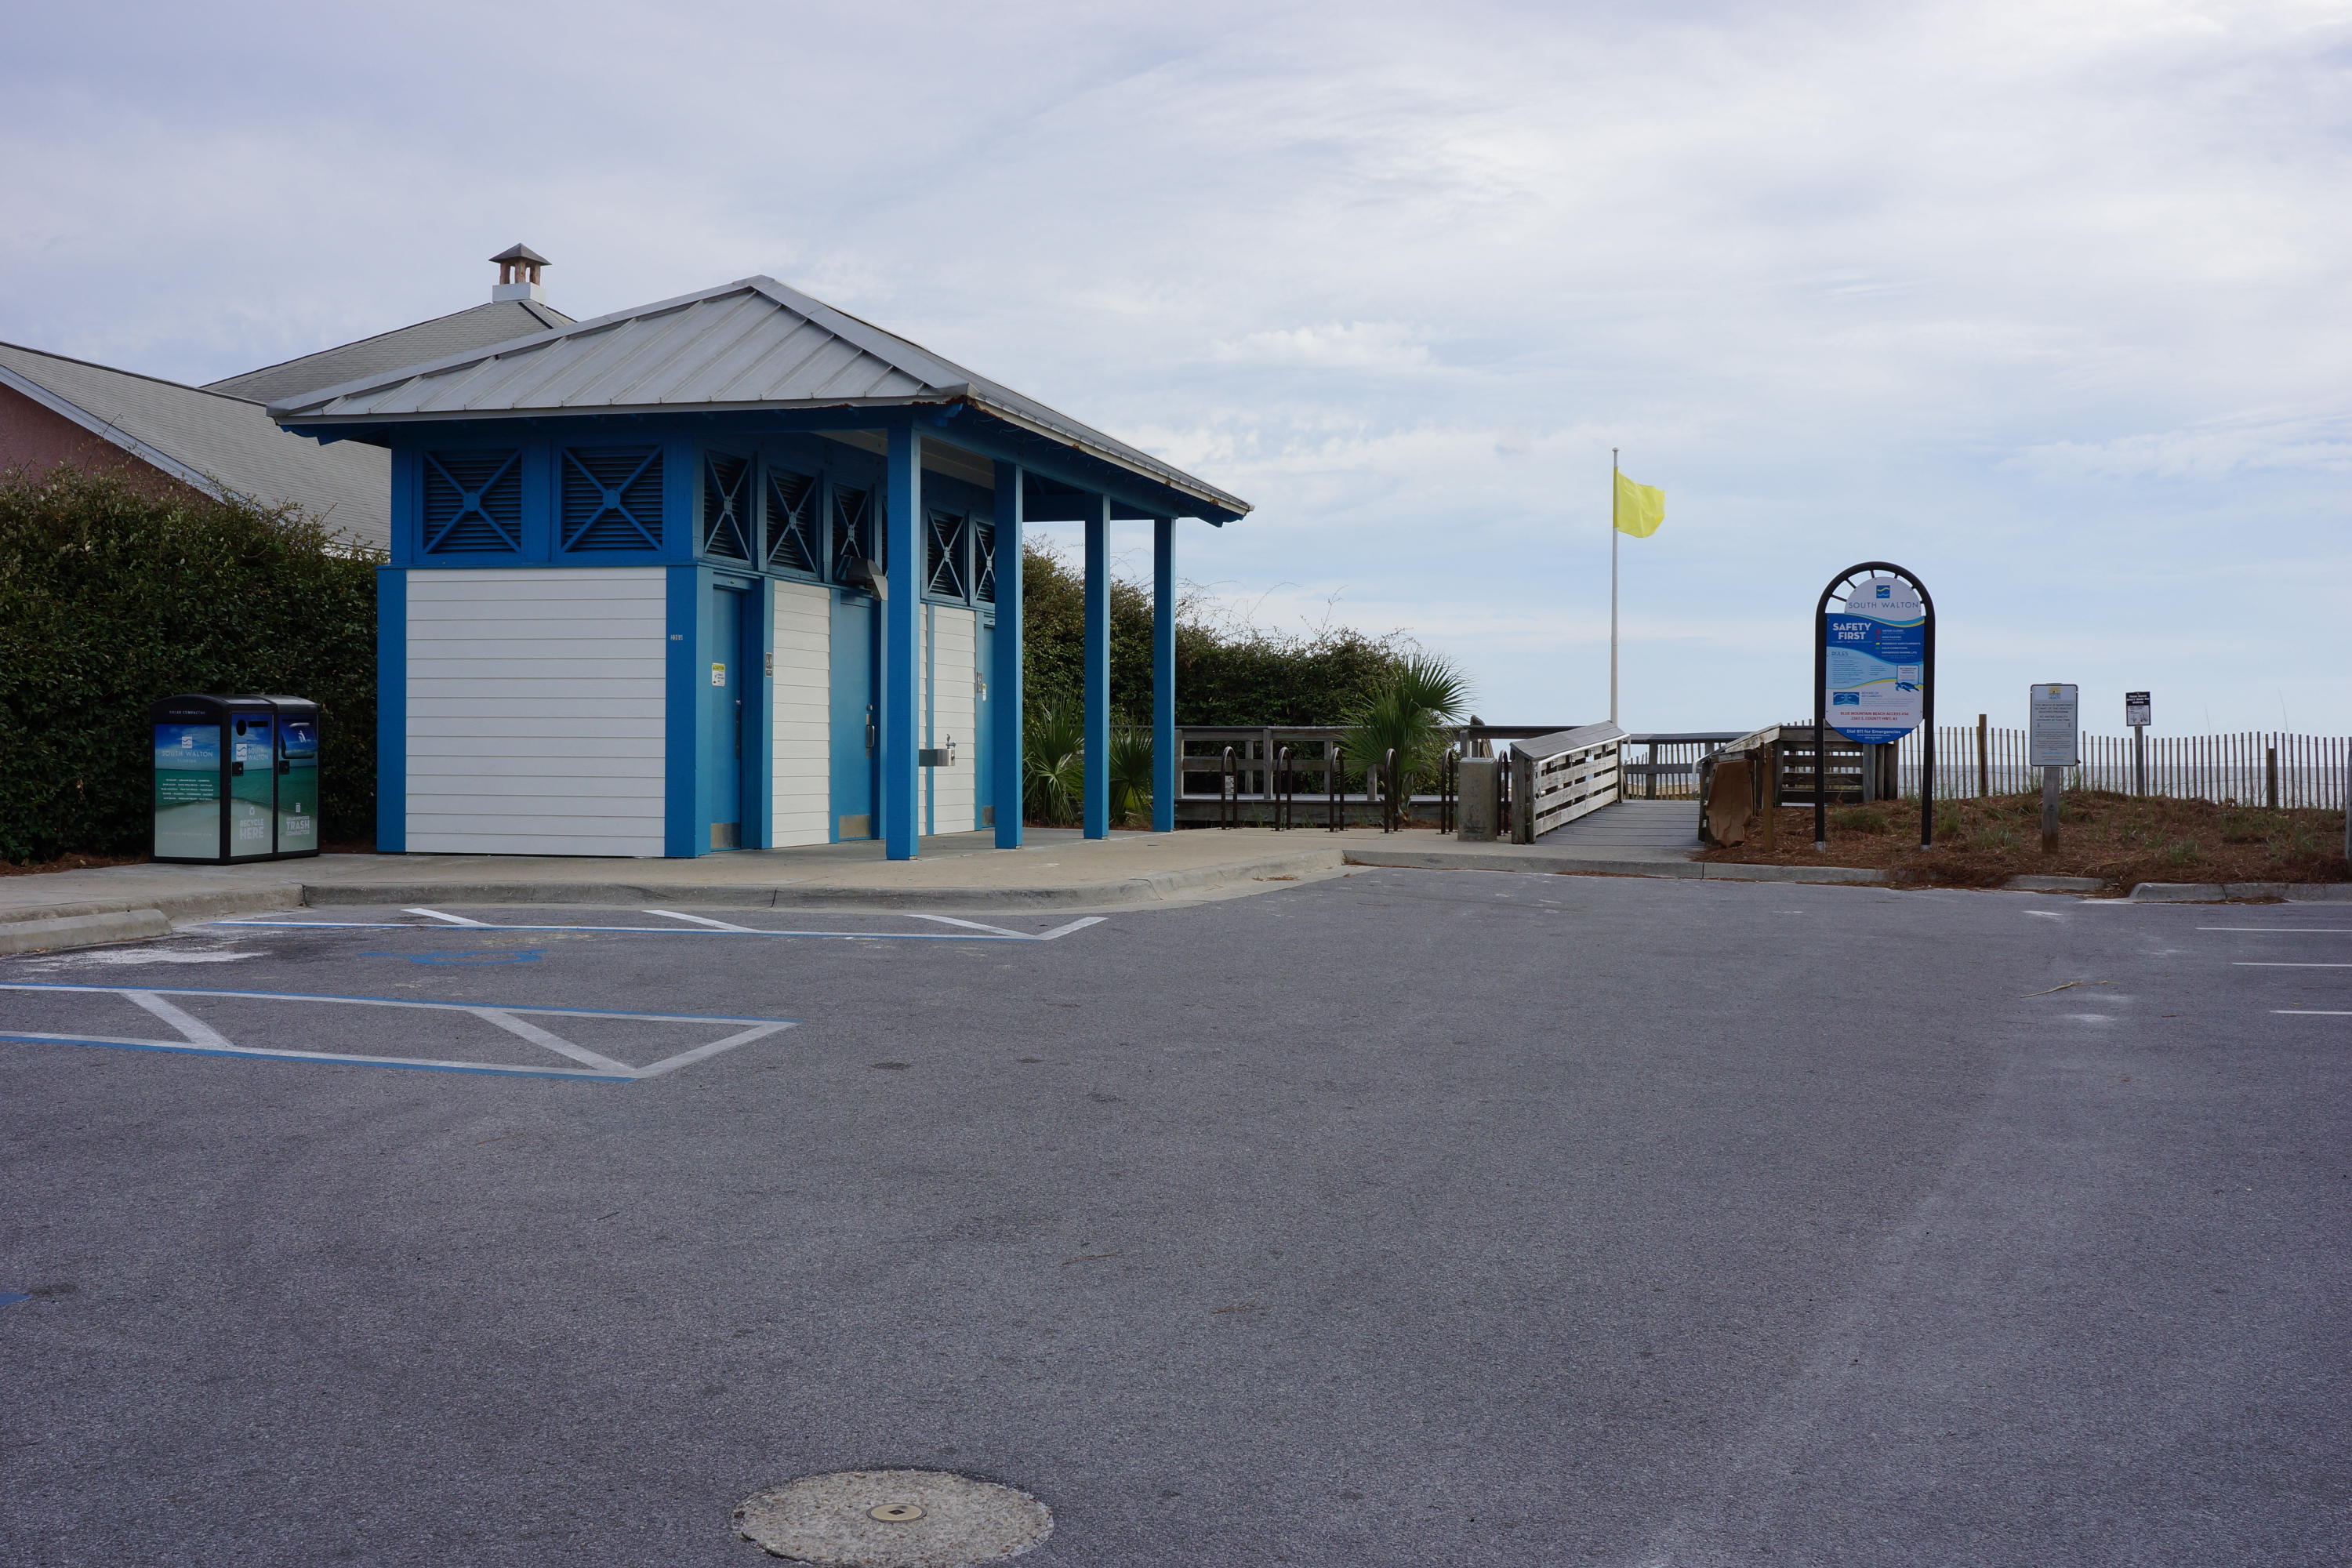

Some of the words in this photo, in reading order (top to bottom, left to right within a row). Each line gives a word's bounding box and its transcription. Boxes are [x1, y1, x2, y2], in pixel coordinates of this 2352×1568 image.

[239, 818, 264, 827] RECYCLE
[286, 819, 310, 830] TRASH
[239, 826, 264, 840] HERE
